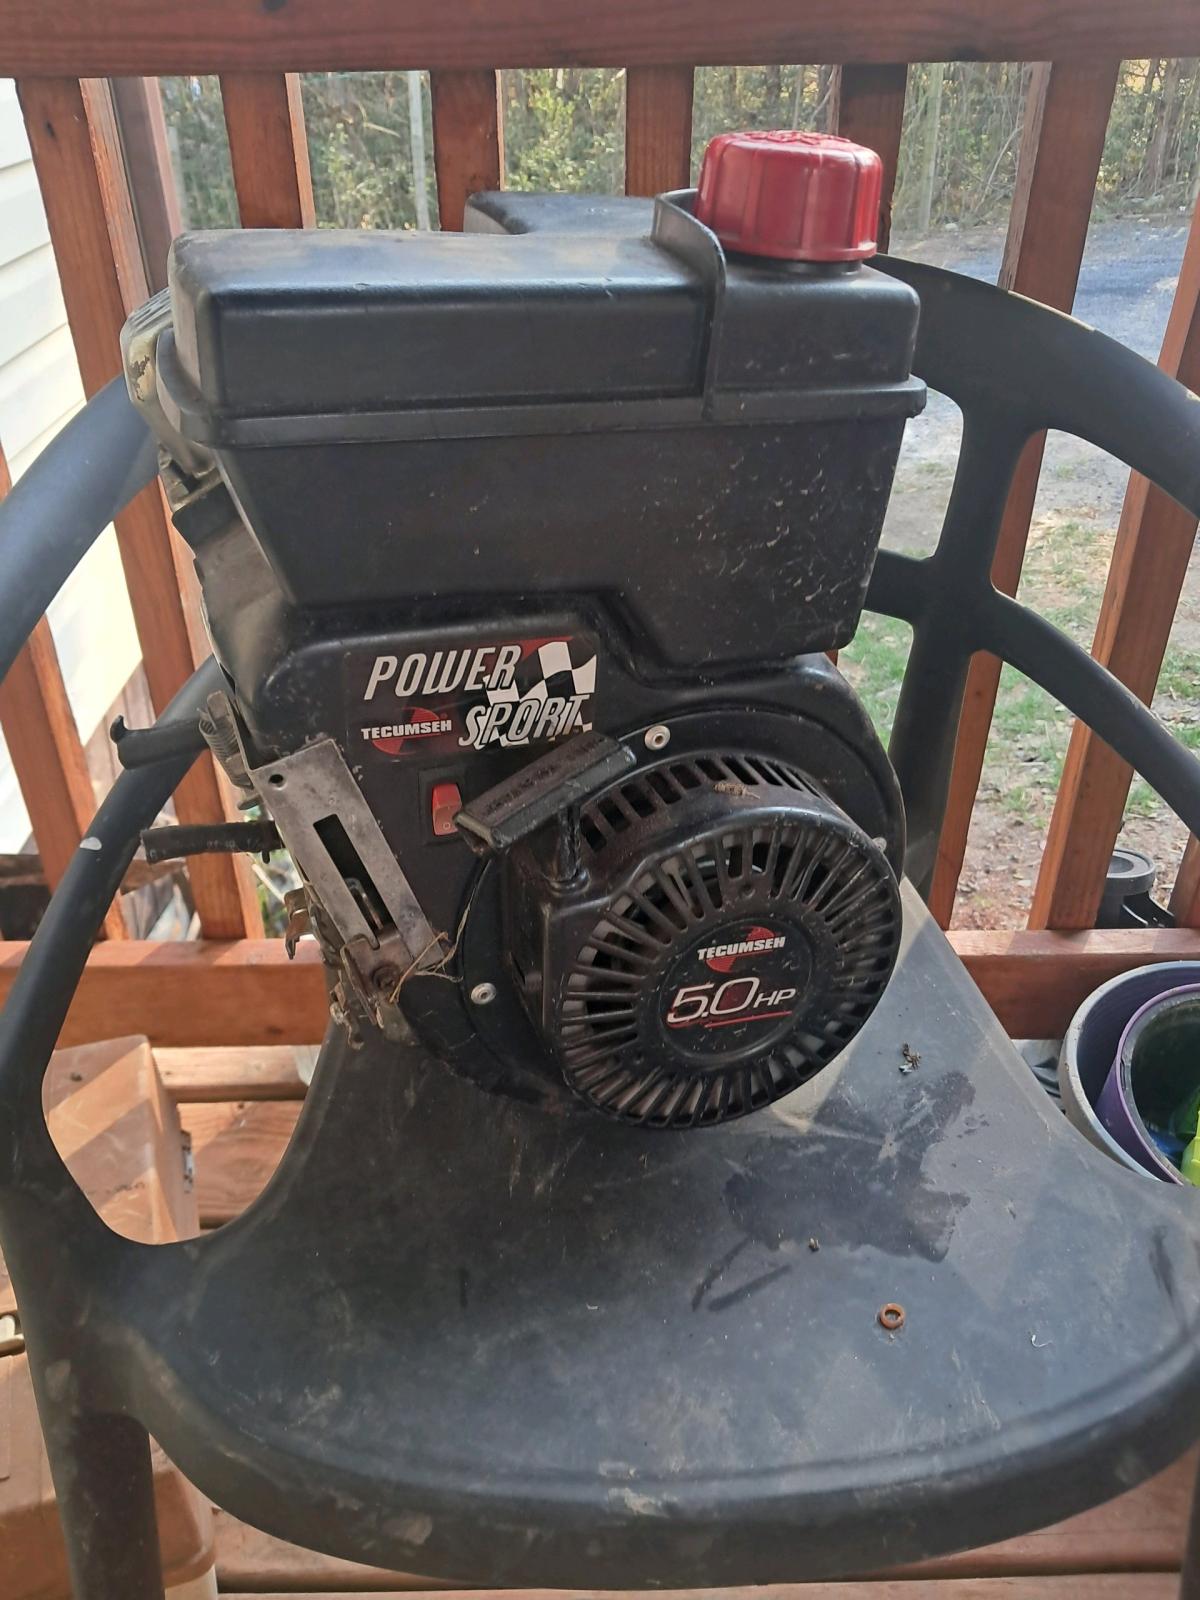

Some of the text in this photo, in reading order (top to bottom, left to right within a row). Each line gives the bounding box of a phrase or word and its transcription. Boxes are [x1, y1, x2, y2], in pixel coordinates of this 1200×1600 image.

[364, 645, 521, 700] POWER
[361, 719, 452, 740] TECUMSEH
[458, 694, 590, 747] SPORT
[697, 936, 786, 960] TECUMSEH
[667, 976, 797, 1024] 5.0 HP
